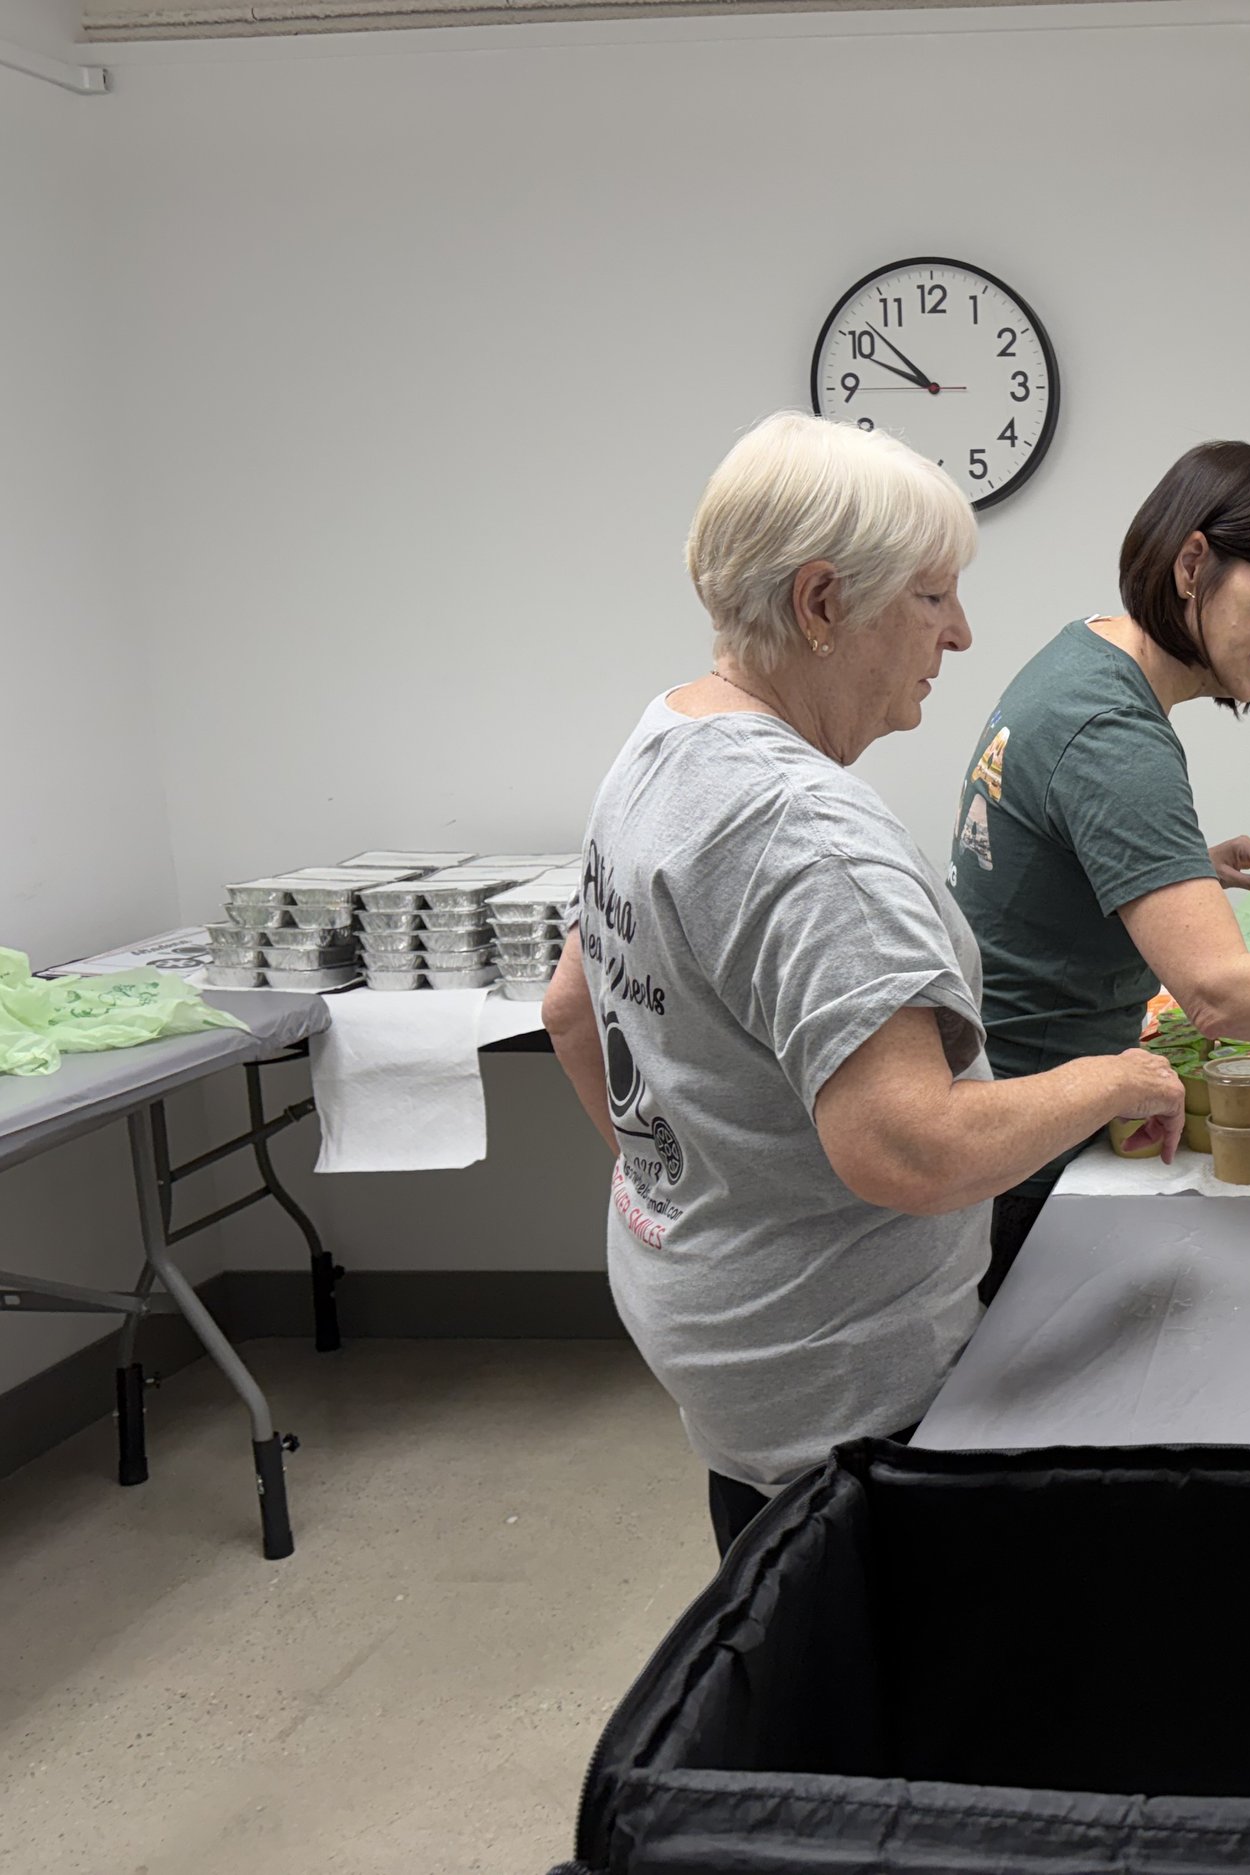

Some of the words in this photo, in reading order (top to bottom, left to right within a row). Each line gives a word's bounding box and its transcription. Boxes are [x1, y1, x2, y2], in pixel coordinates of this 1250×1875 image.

[879, 298, 903, 327] 11
[917, 284, 947, 314] 12
[969, 295, 978, 325] 1
[848, 330, 875, 360] 10
[996, 327, 1017, 357] 2
[841, 372, 860, 403] 9
[1009, 370, 1030, 402] 3
[996, 416, 1018, 448] 4
[968, 449, 988, 479] 5
[628, 1207, 666, 1250] SMILES
